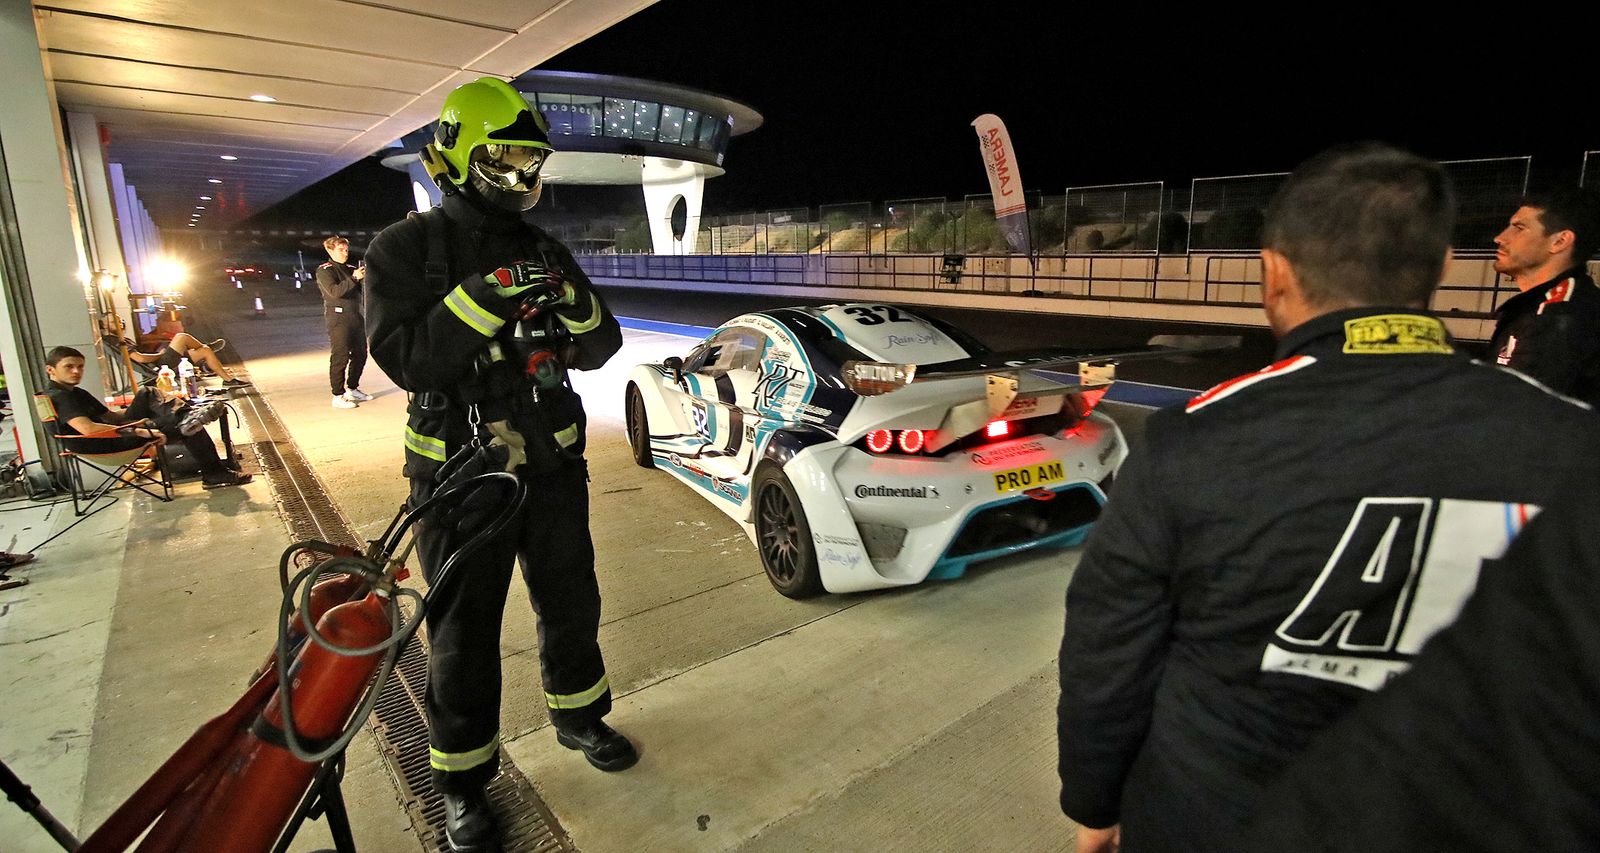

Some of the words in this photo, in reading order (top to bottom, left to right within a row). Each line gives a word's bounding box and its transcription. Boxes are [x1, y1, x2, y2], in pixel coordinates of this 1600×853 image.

[843, 305, 914, 326] 32
[1038, 462, 1064, 482] AM
[854, 484, 928, 499] Continental
